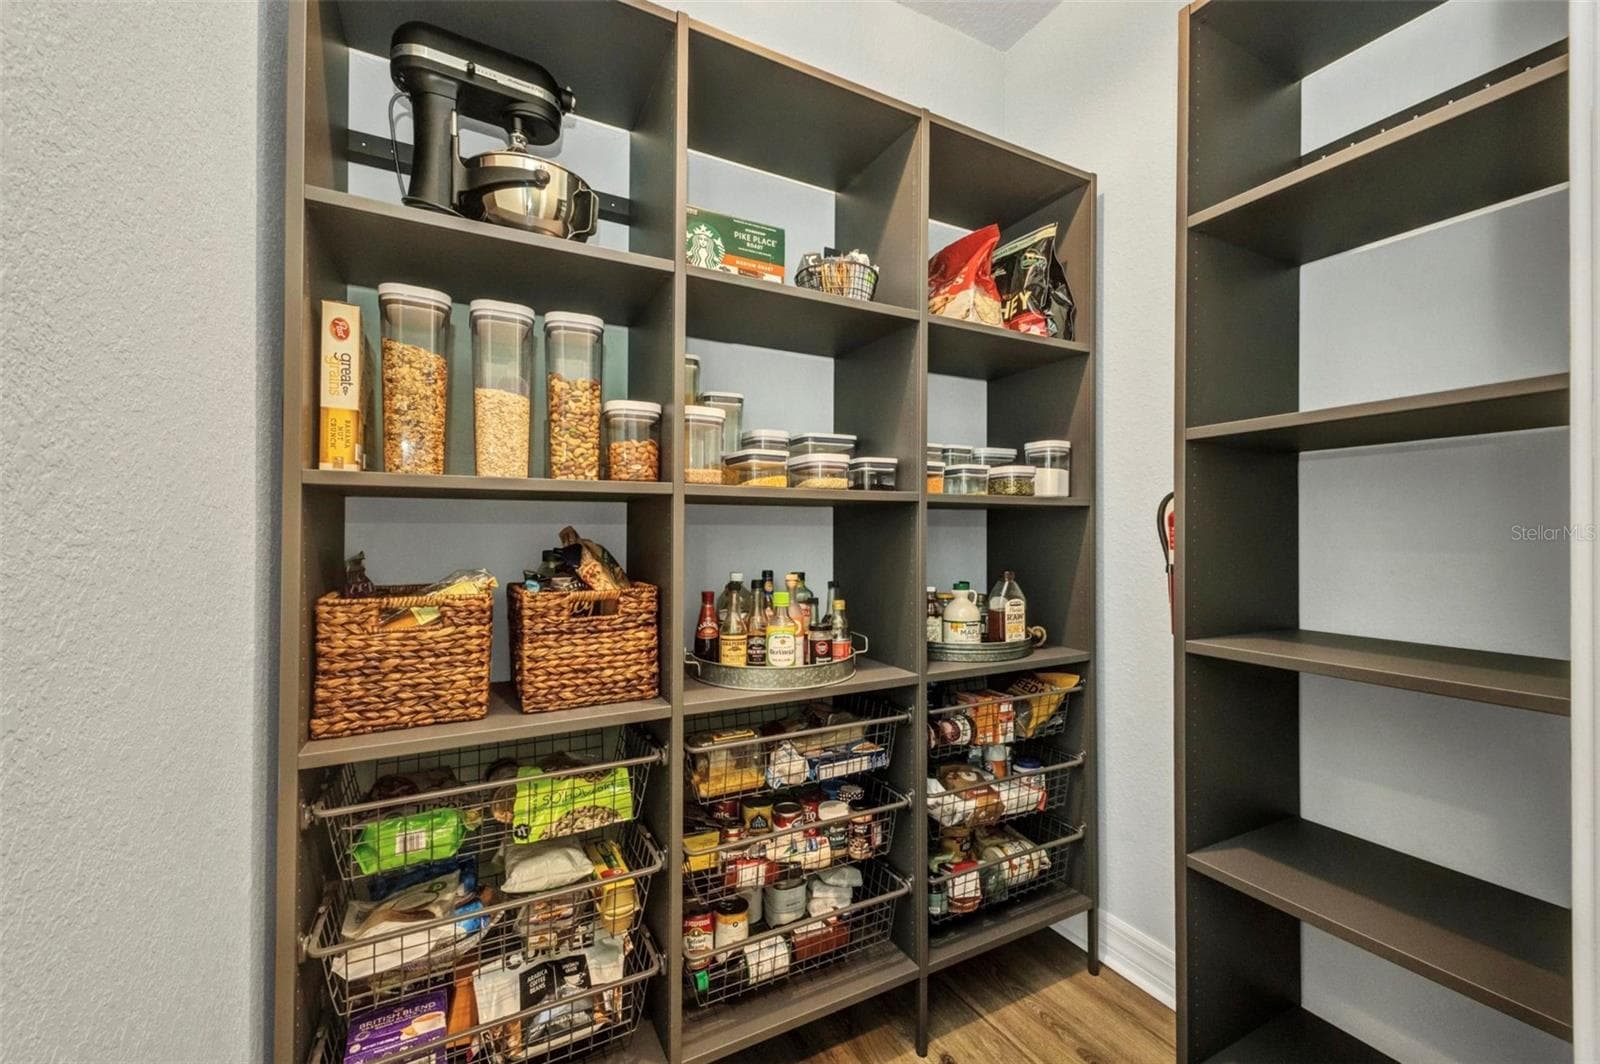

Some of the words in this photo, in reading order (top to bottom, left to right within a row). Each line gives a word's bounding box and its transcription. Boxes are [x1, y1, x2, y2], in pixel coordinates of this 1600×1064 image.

[734, 231, 751, 241] PIKE
[752, 236, 777, 247] PLACE
[334, 352, 353, 386] great
[527, 969, 549, 983] ARABICA
[529, 976, 546, 988] COFFEE
[529, 983, 546, 995] BEANS
[359, 1011, 401, 1030] BRITISH
[402, 1001, 437, 1016] BLEND
